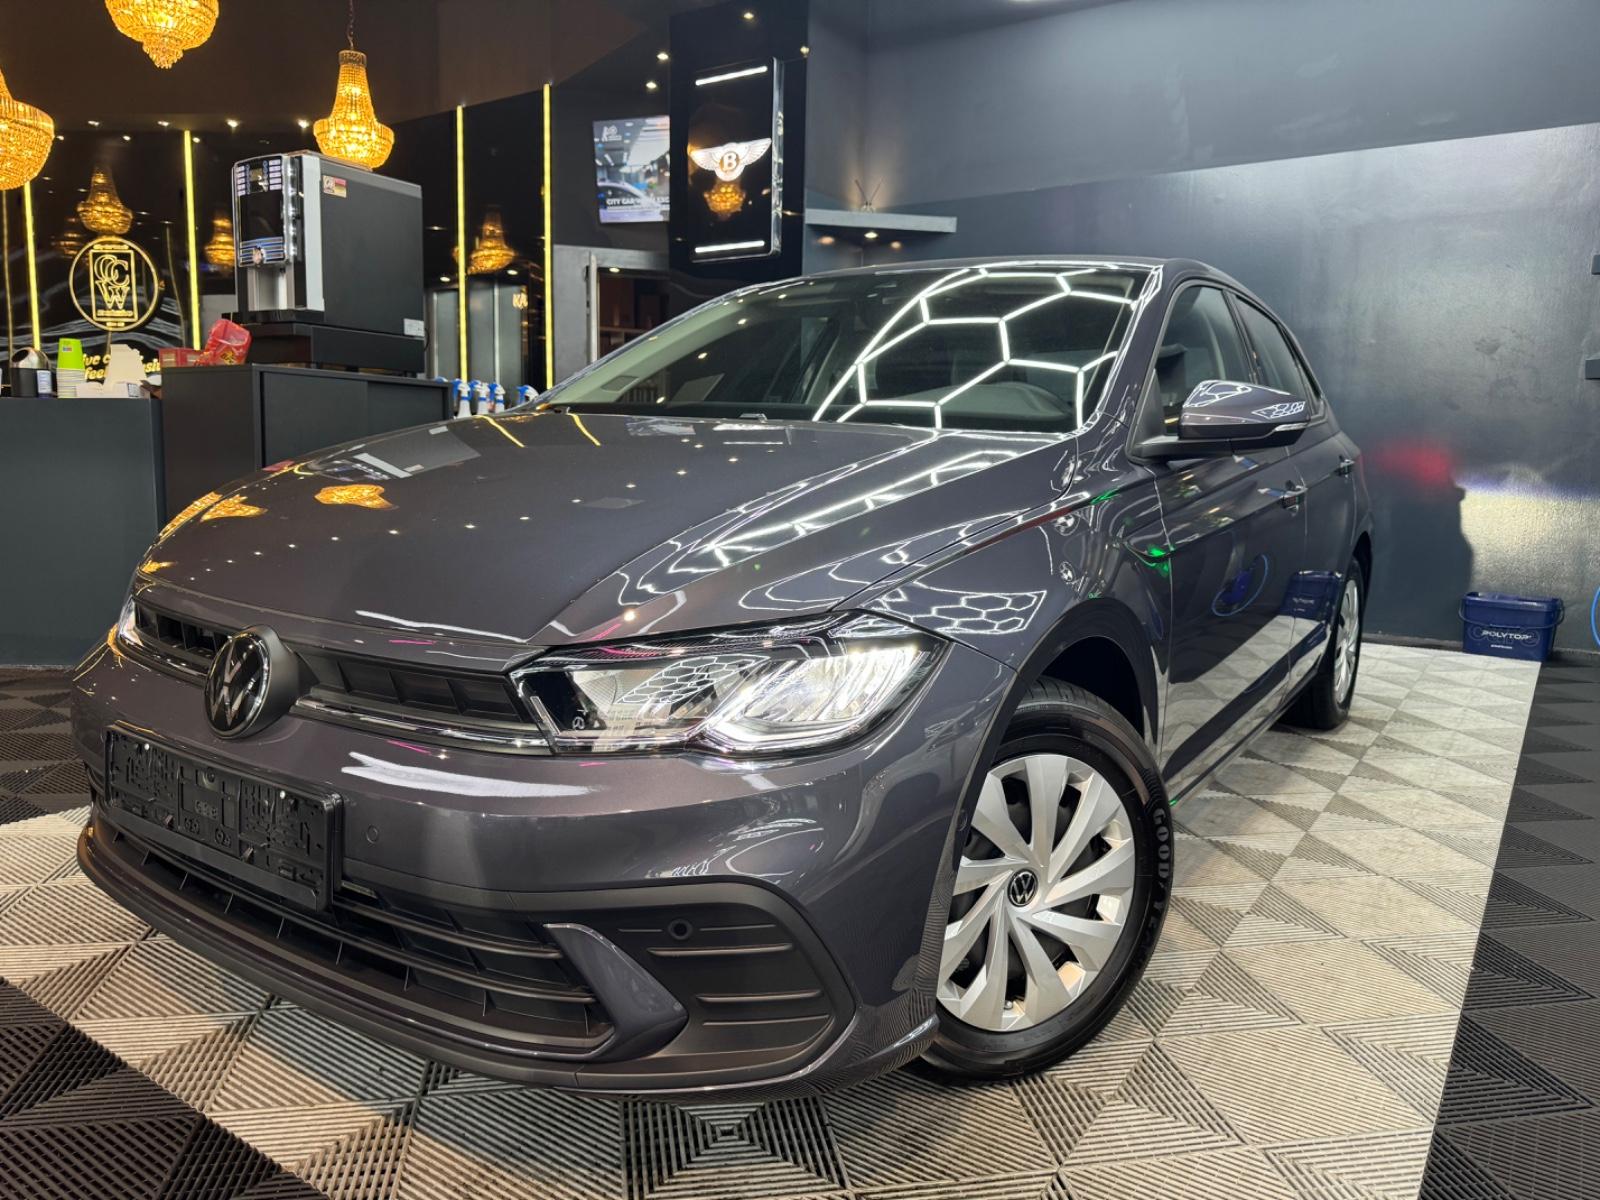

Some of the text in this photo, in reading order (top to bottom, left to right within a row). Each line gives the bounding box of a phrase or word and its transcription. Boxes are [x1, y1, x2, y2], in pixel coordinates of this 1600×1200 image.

[721, 152, 737, 171] B
[84, 366, 105, 380] fee
[1481, 630, 1530, 640] POLYTOP
